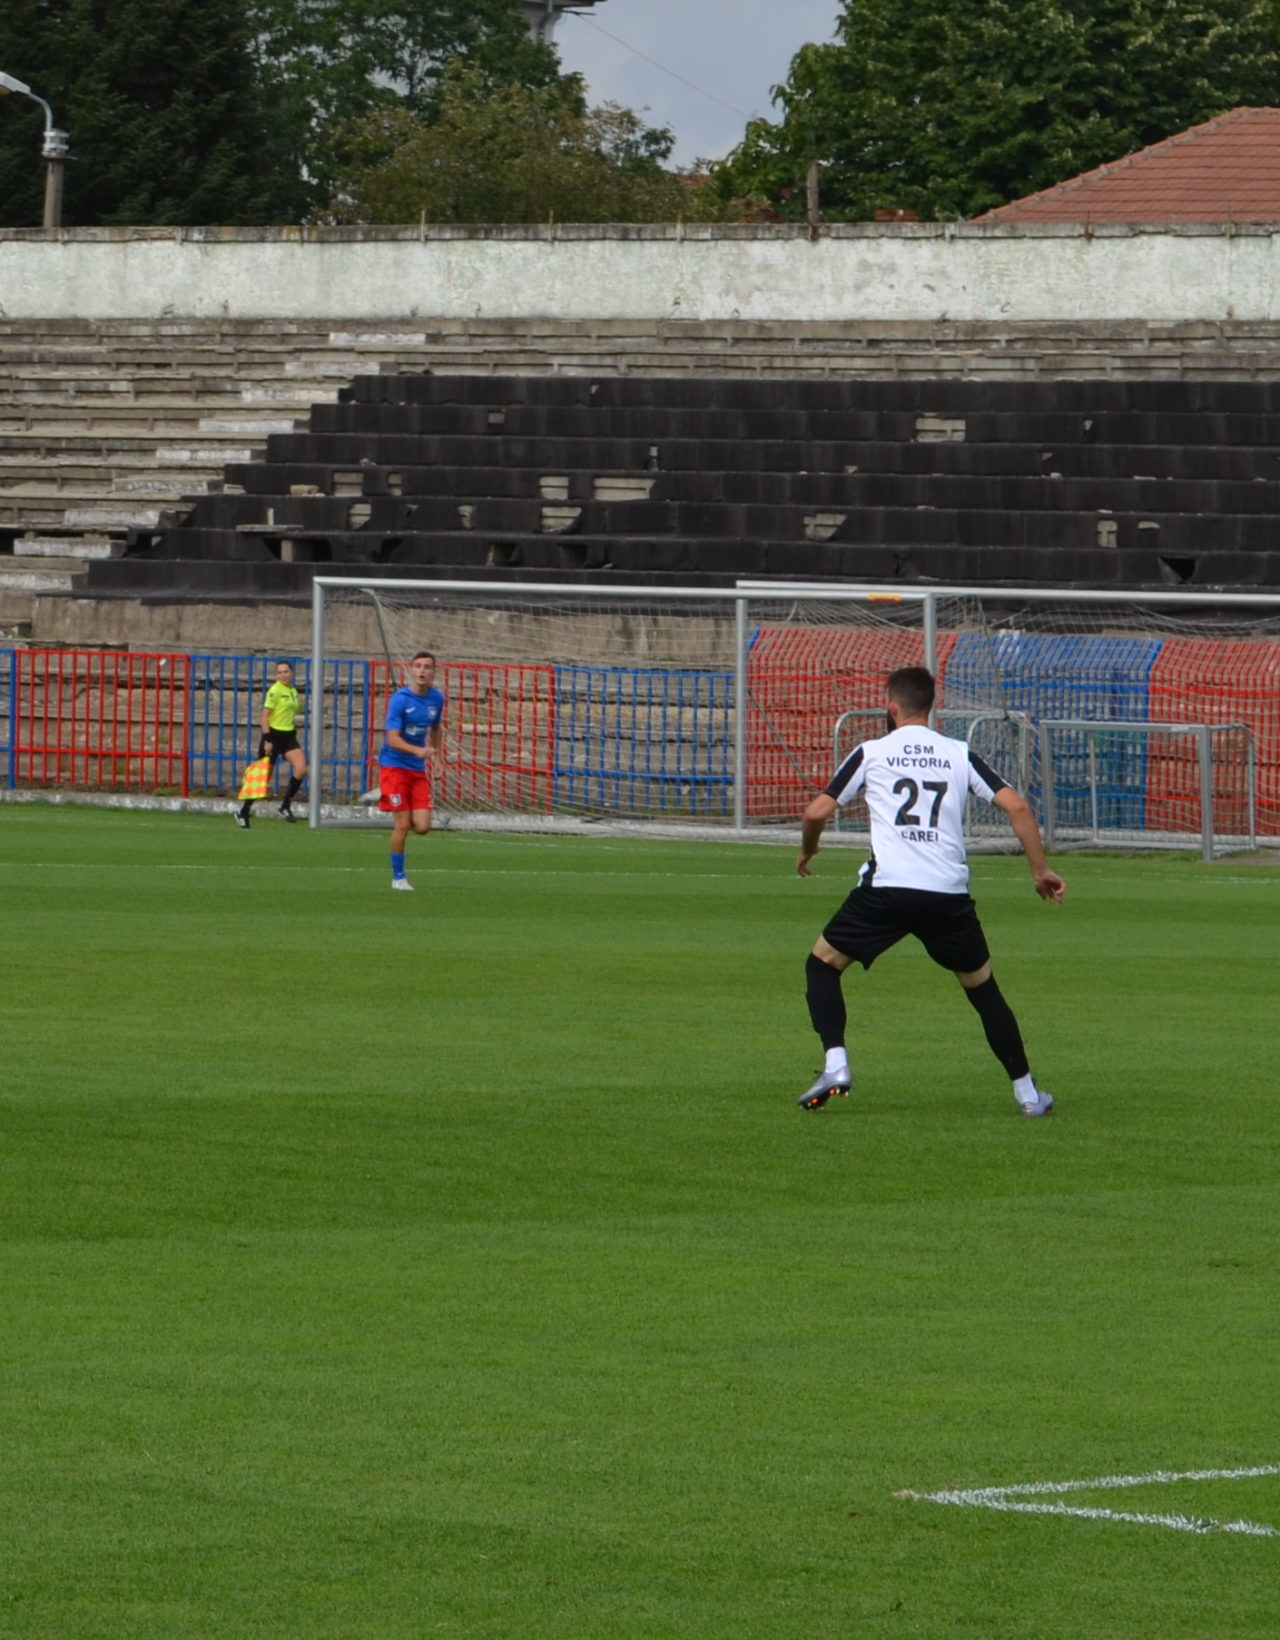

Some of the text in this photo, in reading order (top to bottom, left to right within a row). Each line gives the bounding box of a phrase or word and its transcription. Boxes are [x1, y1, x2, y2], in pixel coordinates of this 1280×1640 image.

[903, 744, 935, 755] CSM
[886, 756, 952, 770] VICTORIA
[892, 777, 949, 828] 27
